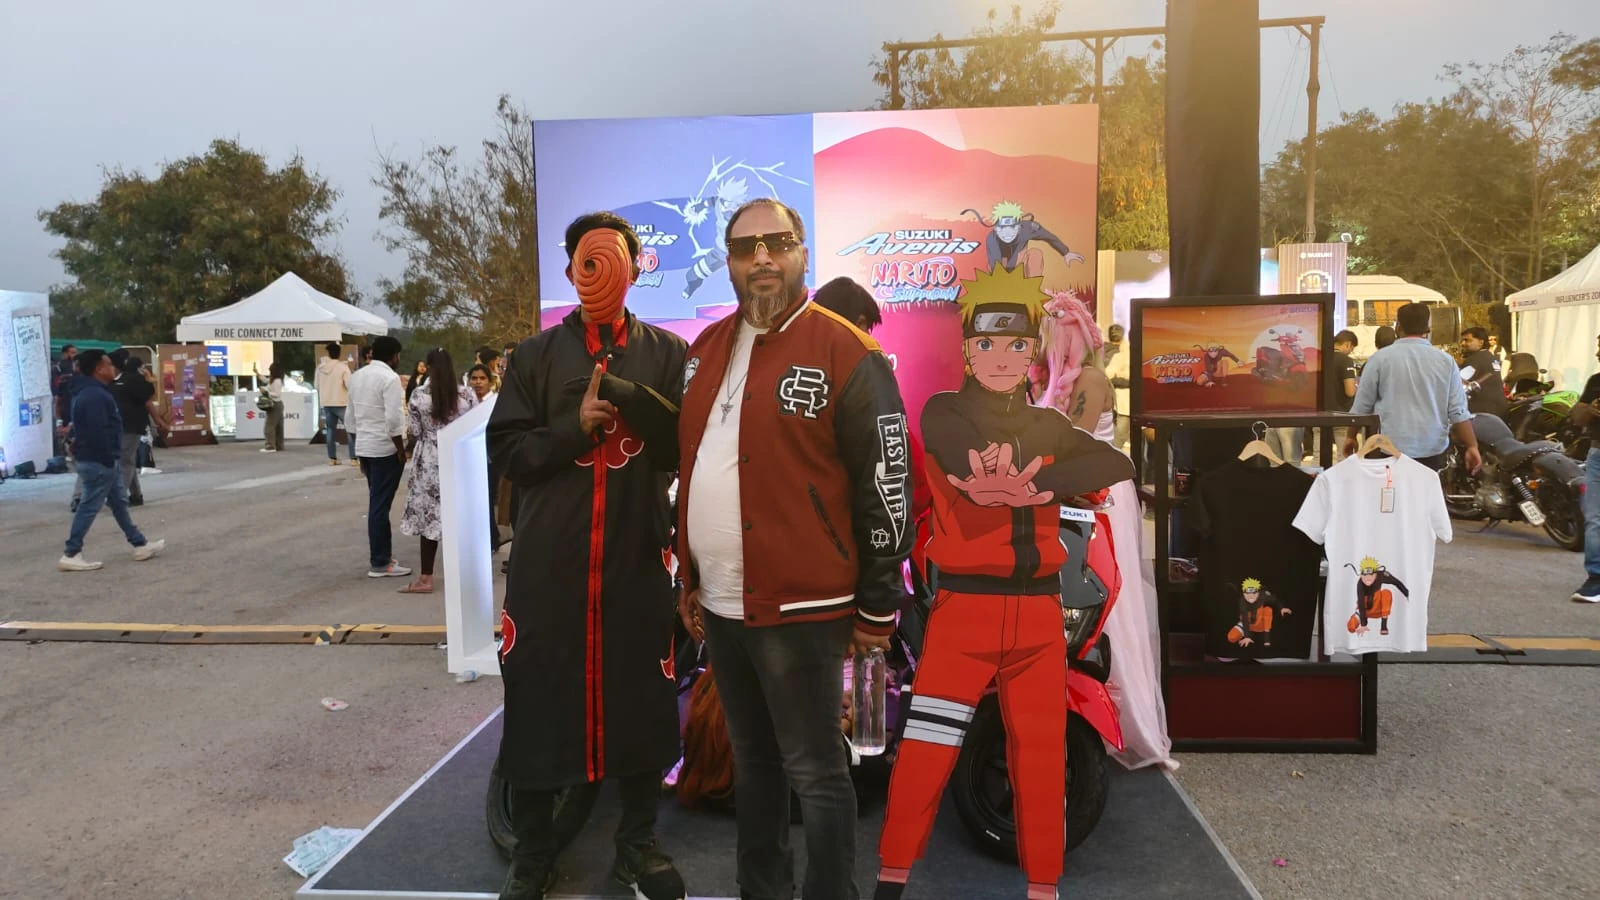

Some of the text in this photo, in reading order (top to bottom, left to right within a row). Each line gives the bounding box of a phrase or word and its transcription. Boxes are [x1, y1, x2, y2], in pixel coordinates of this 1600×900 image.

[837, 232, 981, 256] Avenis
[895, 230, 951, 240] SUZUKI
[870, 259, 956, 288] NARUTO
[214, 327, 304, 338] RIDE CONNECT ZONE
[884, 422, 905, 467] EASY
[881, 480, 903, 520] LIFE
[1061, 509, 1088, 519] ZUKI
